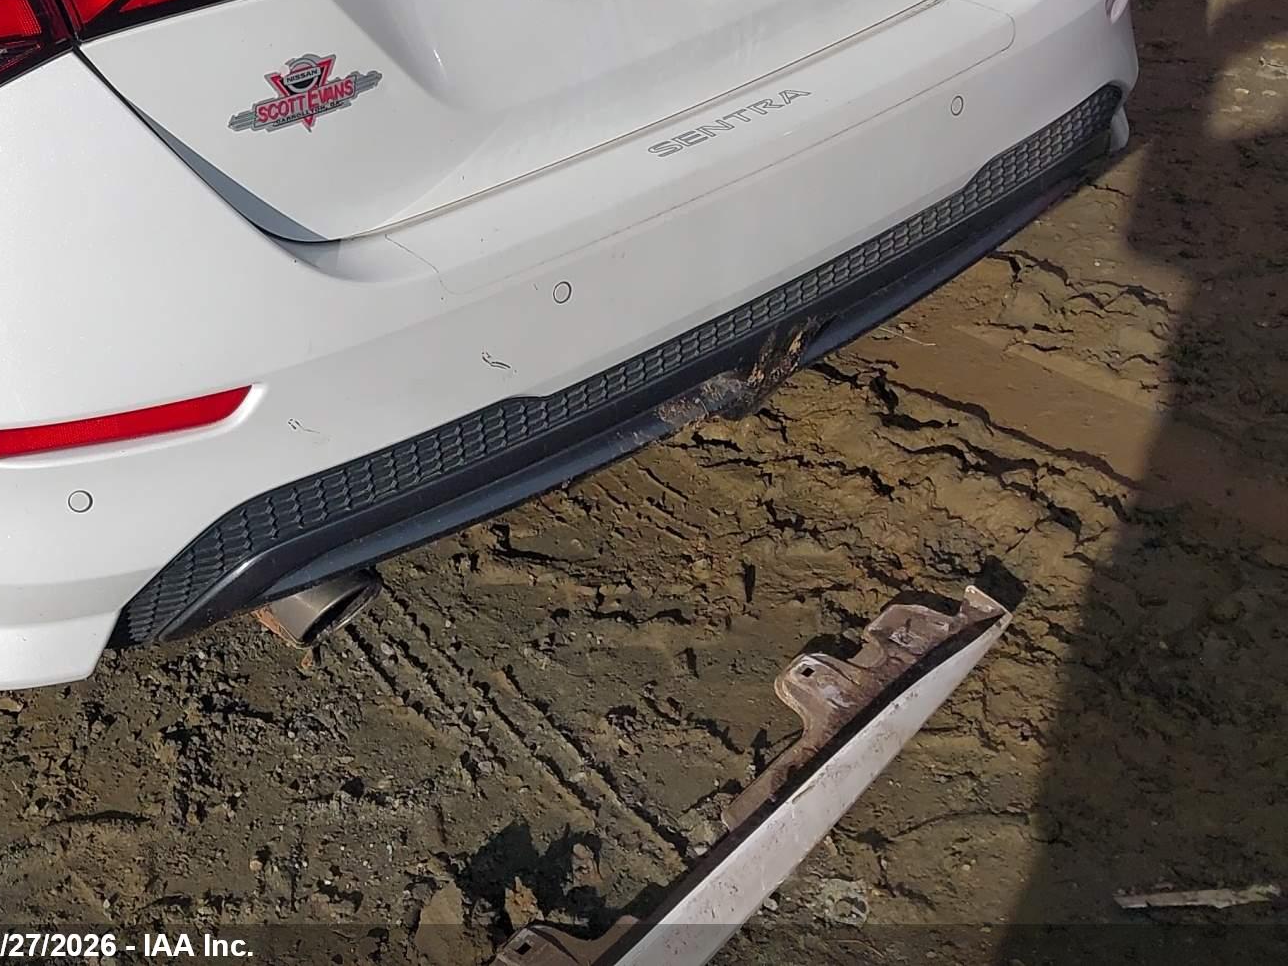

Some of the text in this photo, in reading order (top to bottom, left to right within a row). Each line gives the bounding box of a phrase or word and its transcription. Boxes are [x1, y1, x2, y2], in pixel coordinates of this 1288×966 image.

[286, 69, 318, 83] NISSAN
[257, 95, 306, 123] SCOTT
[648, 89, 812, 158] SENTRA
